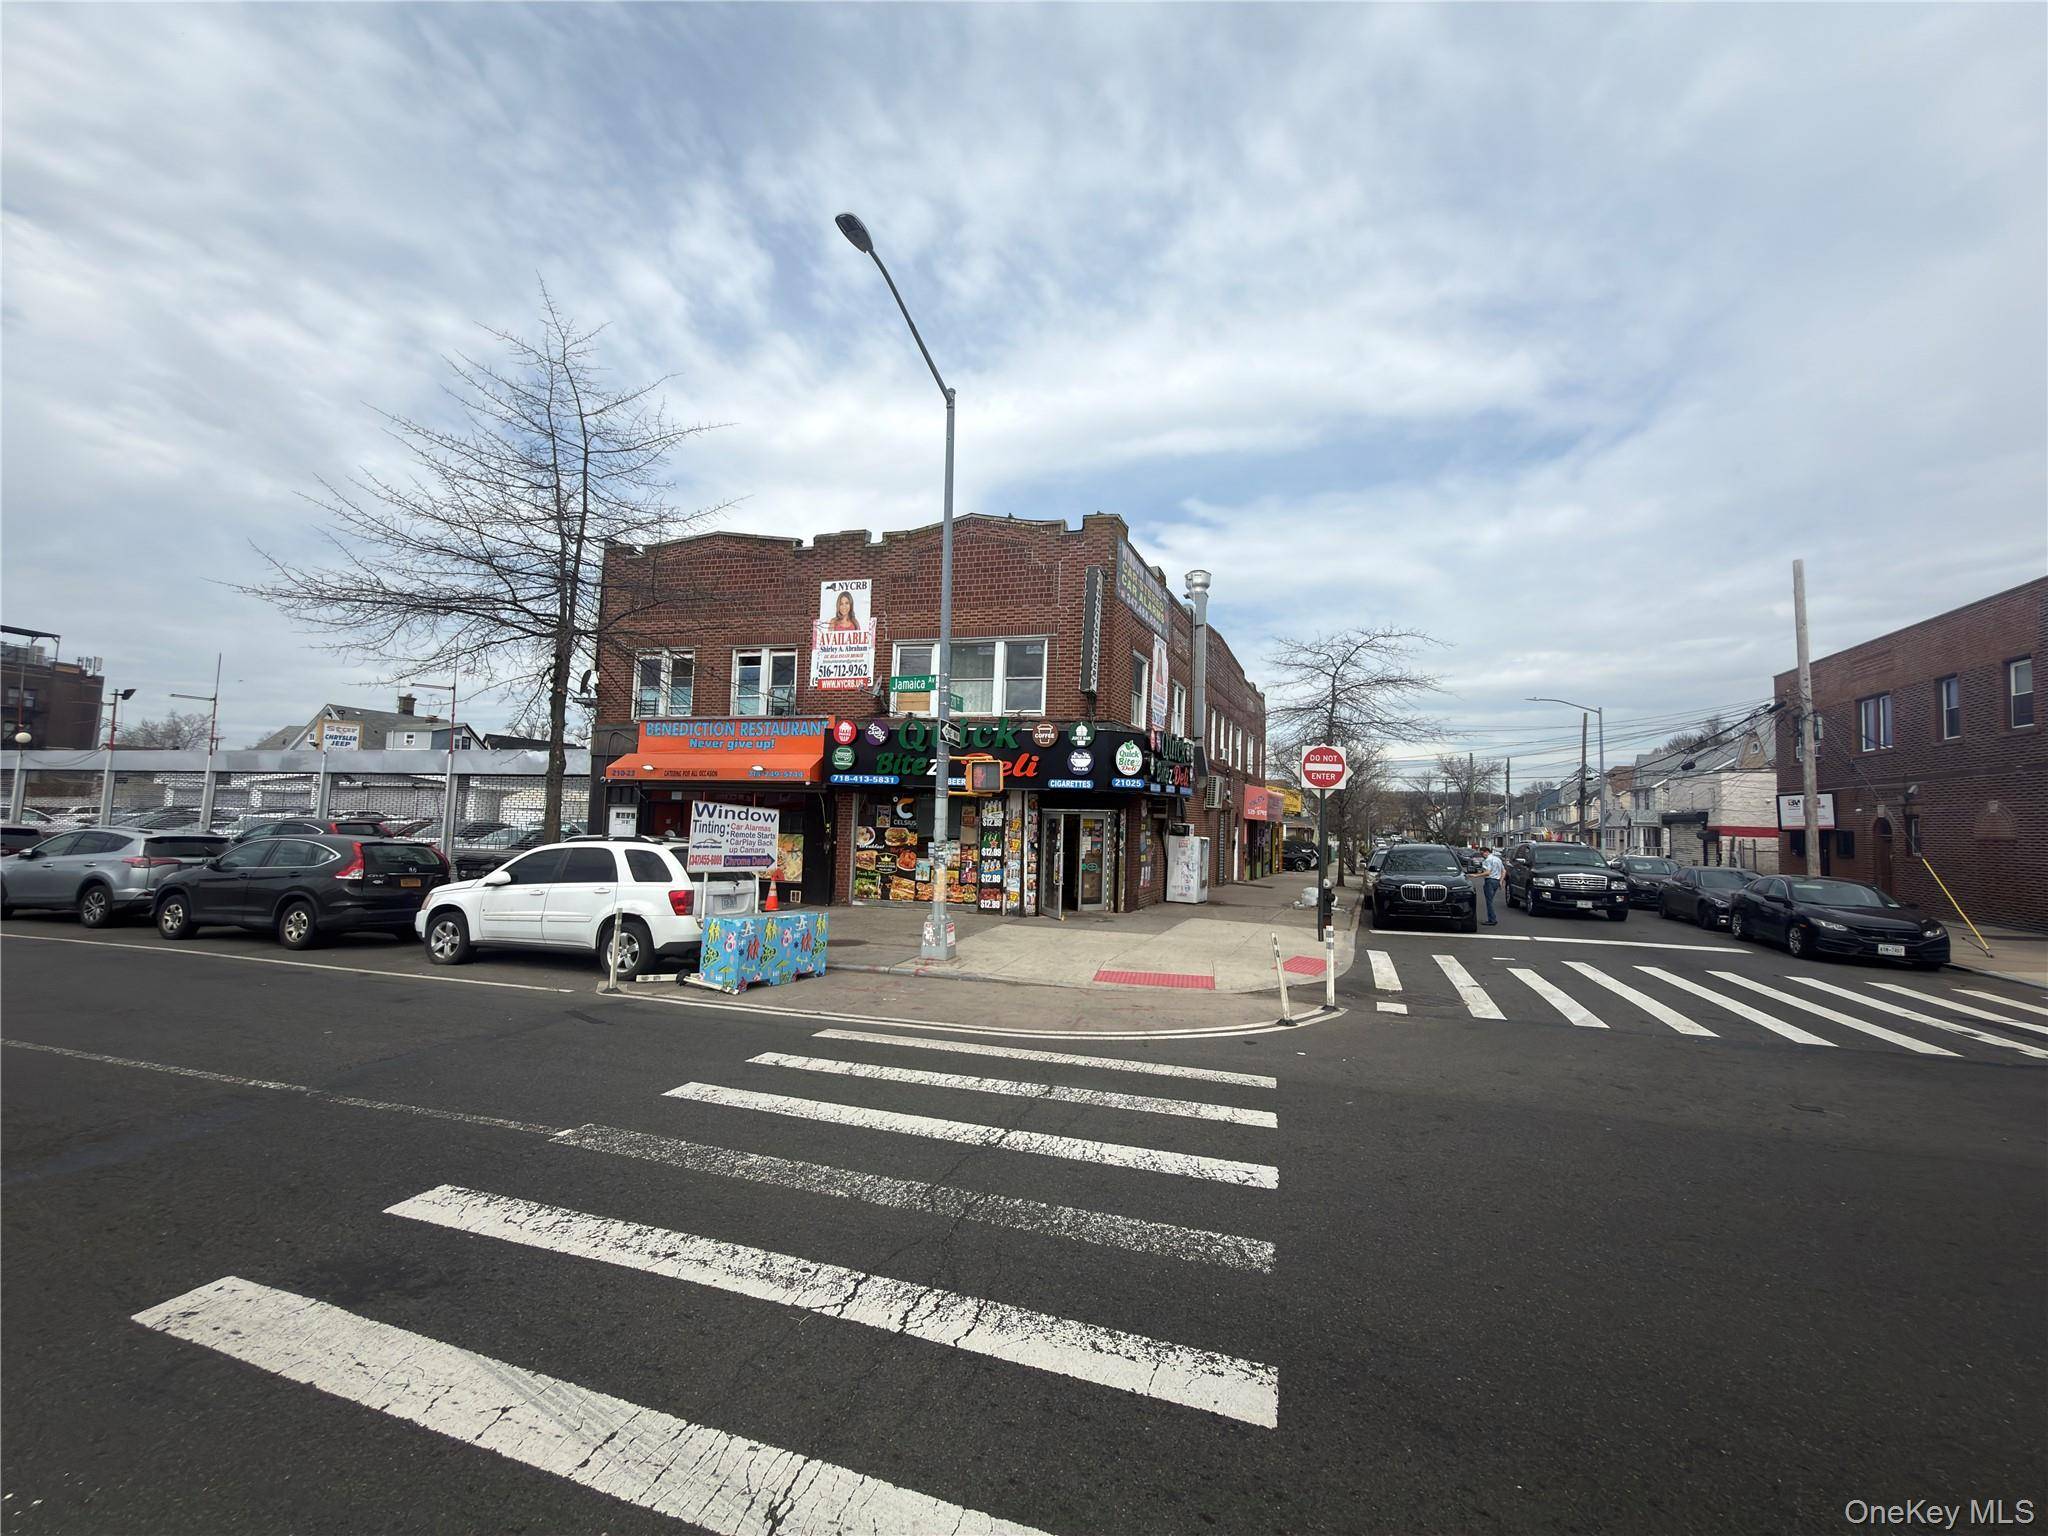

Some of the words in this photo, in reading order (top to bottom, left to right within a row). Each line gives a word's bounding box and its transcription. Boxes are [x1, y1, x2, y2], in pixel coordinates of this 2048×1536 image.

[1122, 560, 1138, 584] CAR
[838, 581, 868, 591] NYCRB
[1121, 574, 1137, 598] CAR
[1138, 591, 1165, 624] ALARMS
[820, 631, 870, 646] AVAILABLE
[818, 664, 868, 677] 516-712-9262
[892, 677, 926, 690] Jamaica
[645, 721, 735, 737] BENEDICTION
[740, 720, 830, 737] RESTAURANT
[325, 734, 358, 742] CHRYSLER
[898, 717, 1022, 752] Qick
[1034, 732, 1055, 740] COFFEE
[689, 738, 725, 749] Never
[727, 738, 753, 751] give
[756, 739, 775, 750] up!
[1119, 749, 1139, 759] Quick
[1310, 754, 1321, 762] DO
[1121, 764, 1137, 772] Deli
[833, 775, 895, 784] 718-413-5831
[947, 777, 966, 785] BEER
[1311, 772, 1336, 780] ENTER
[1049, 779, 1091, 788] CIGARETTES
[1114, 778, 1142, 787] 21025
[694, 803, 777, 823] Window
[692, 820, 726, 838] Tinting
[730, 822, 743, 830] Car
[744, 823, 772, 832] Alarmas
[729, 831, 756, 839] Remote
[756, 831, 776, 840] Starts
[729, 838, 756, 847] CarPlay
[739, 846, 766, 854] Camara
